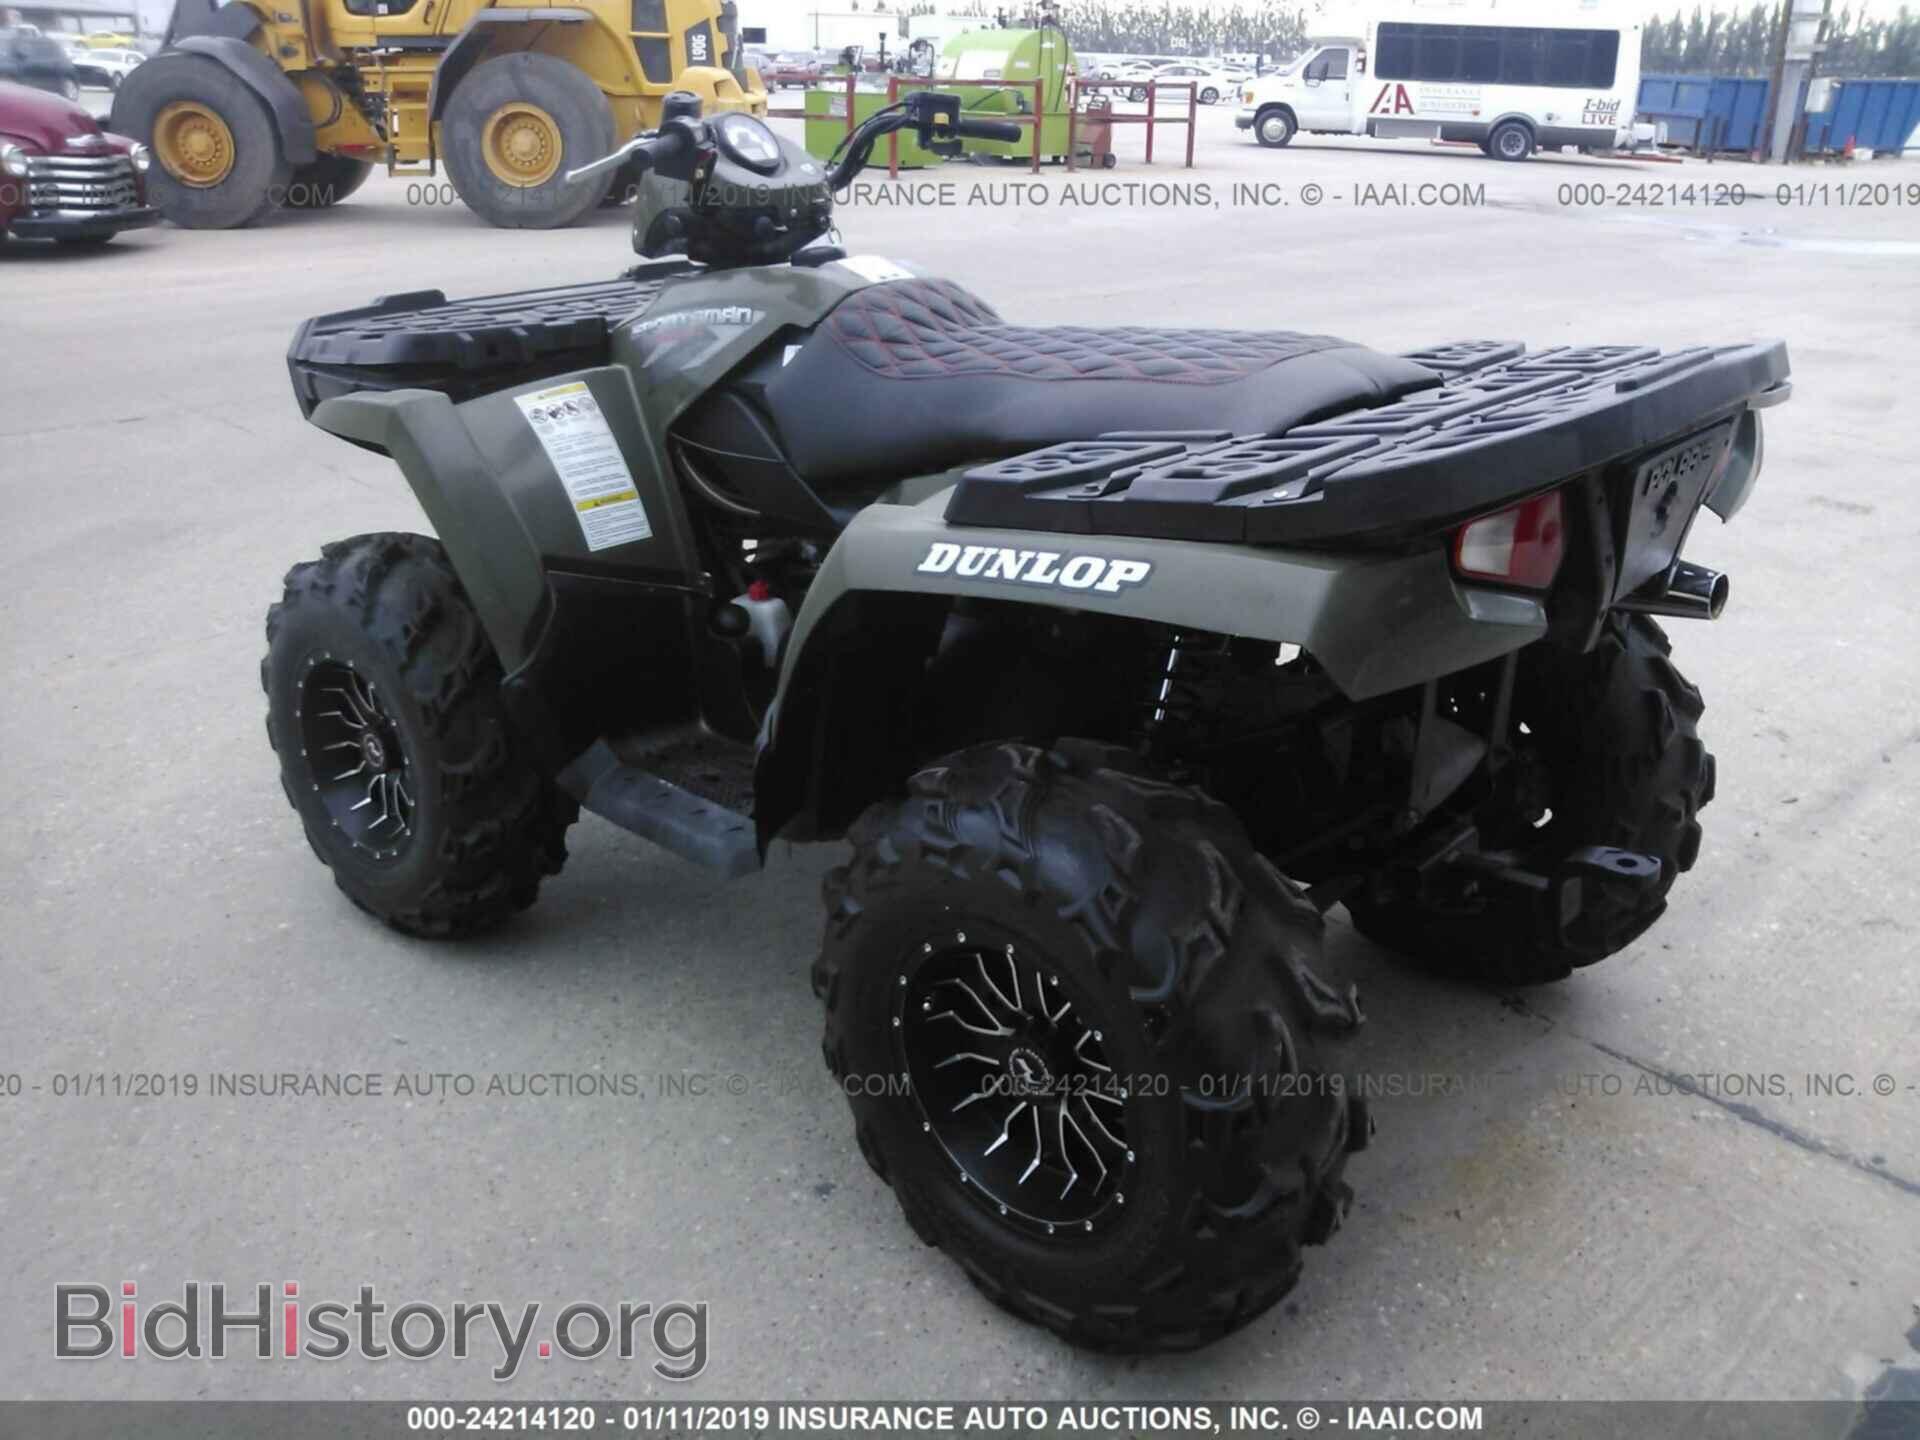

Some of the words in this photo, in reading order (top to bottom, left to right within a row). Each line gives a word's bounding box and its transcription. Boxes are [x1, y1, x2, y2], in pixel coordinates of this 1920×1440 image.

[1584, 98, 1621, 111] I-bid
[1582, 113, 1617, 126] LIVE
[917, 542, 1151, 593] DUNLOP
